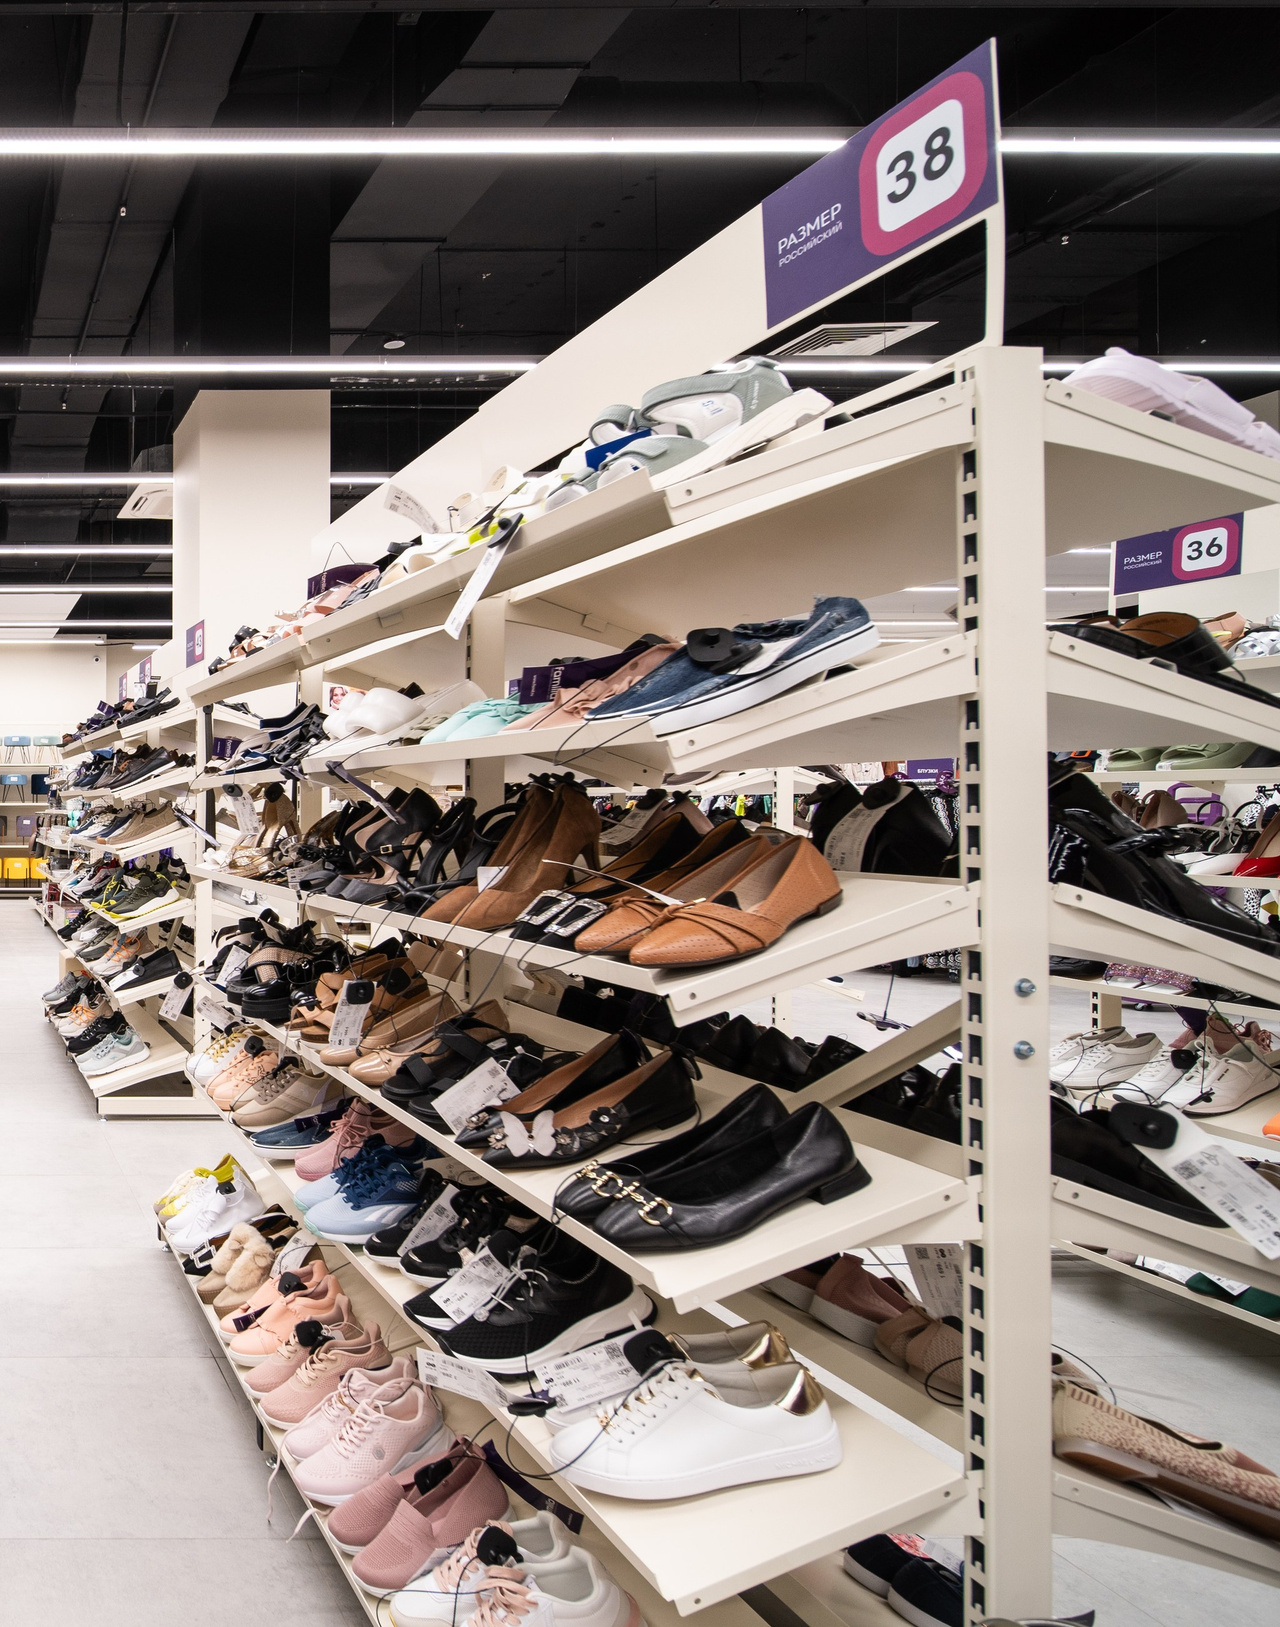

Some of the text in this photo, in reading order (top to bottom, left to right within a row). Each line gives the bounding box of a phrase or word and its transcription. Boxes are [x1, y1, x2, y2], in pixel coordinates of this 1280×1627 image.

[886, 126, 955, 204] 38
[777, 203, 842, 254] РАЗМЕР
[778, 221, 843, 267] РОССИЙСКИЙ
[1123, 551, 1163, 565] РАЗМЕР
[1123, 559, 1163, 571] РОССИЙСКИЙ
[1186, 536, 1223, 561] 36
